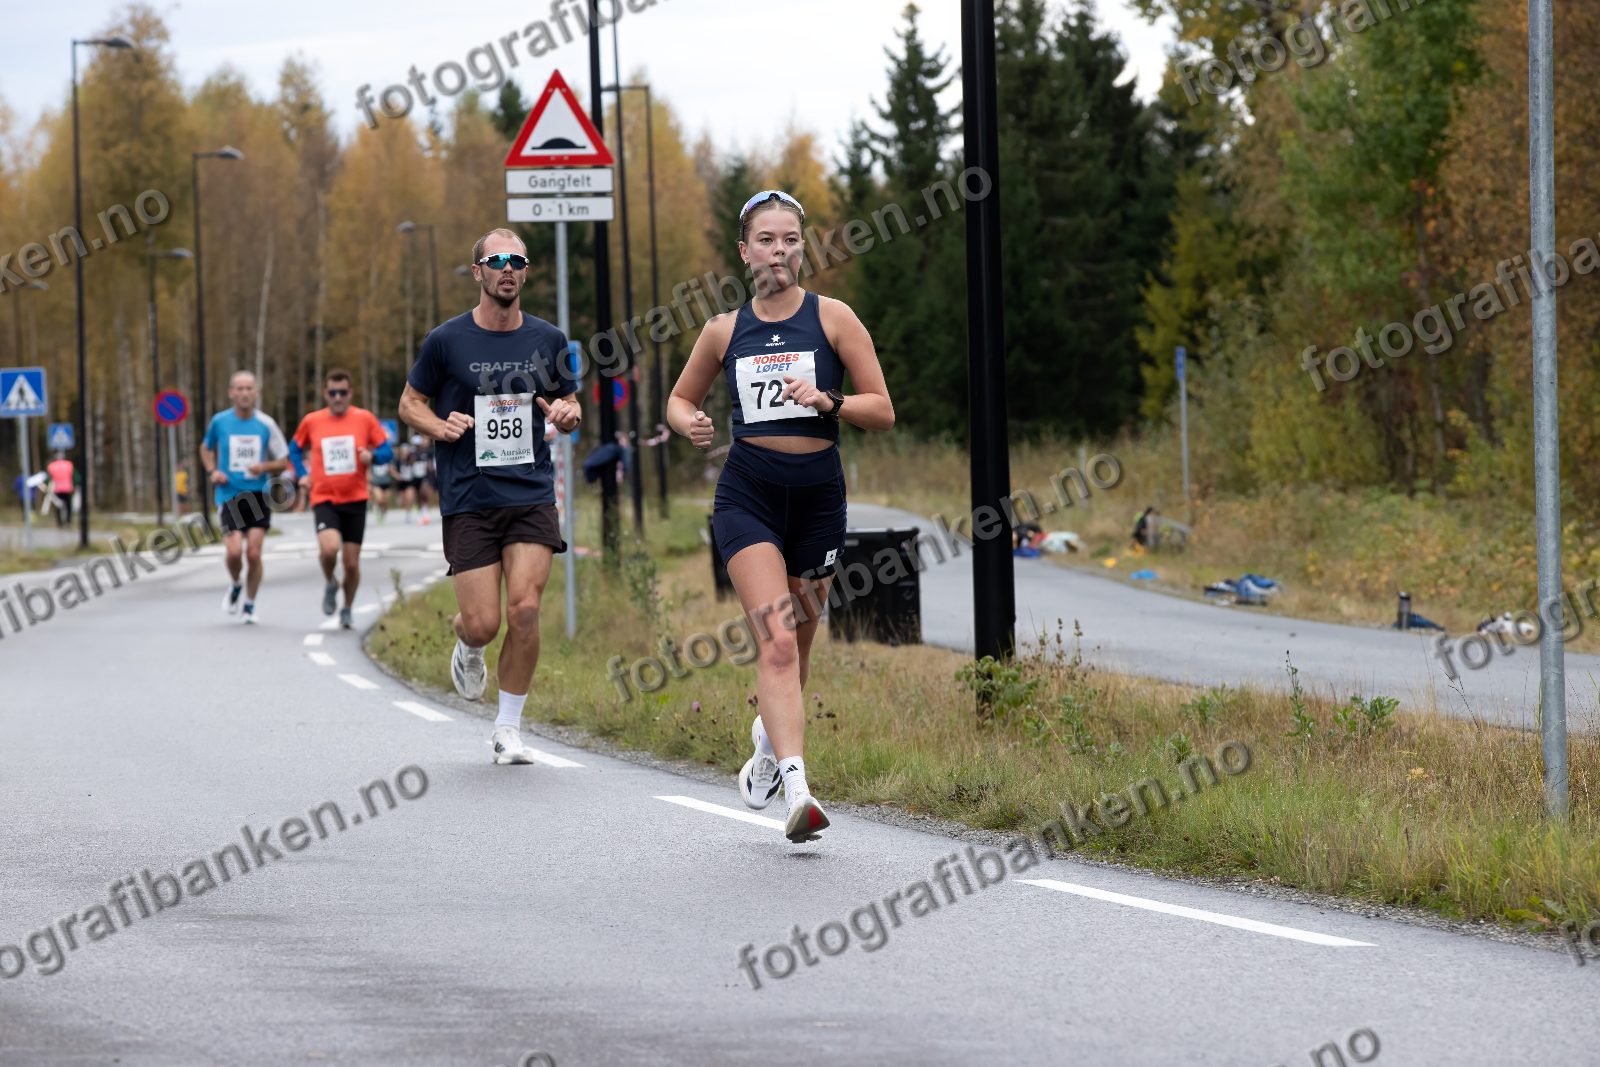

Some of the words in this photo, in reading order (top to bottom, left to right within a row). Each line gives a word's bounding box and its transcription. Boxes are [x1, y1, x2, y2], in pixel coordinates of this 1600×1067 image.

[528, 174, 591, 190] Gangfelt
[532, 203, 542, 217] 0
[558, 203, 563, 216] 1
[568, 202, 590, 216] km
[752, 353, 800, 365] NORGES
[469, 362, 522, 372] CRAFT
[756, 362, 792, 374] LØPET
[488, 399, 523, 408] NORGES
[487, 418, 523, 440] 958
[500, 448, 531, 456] Aurskog
